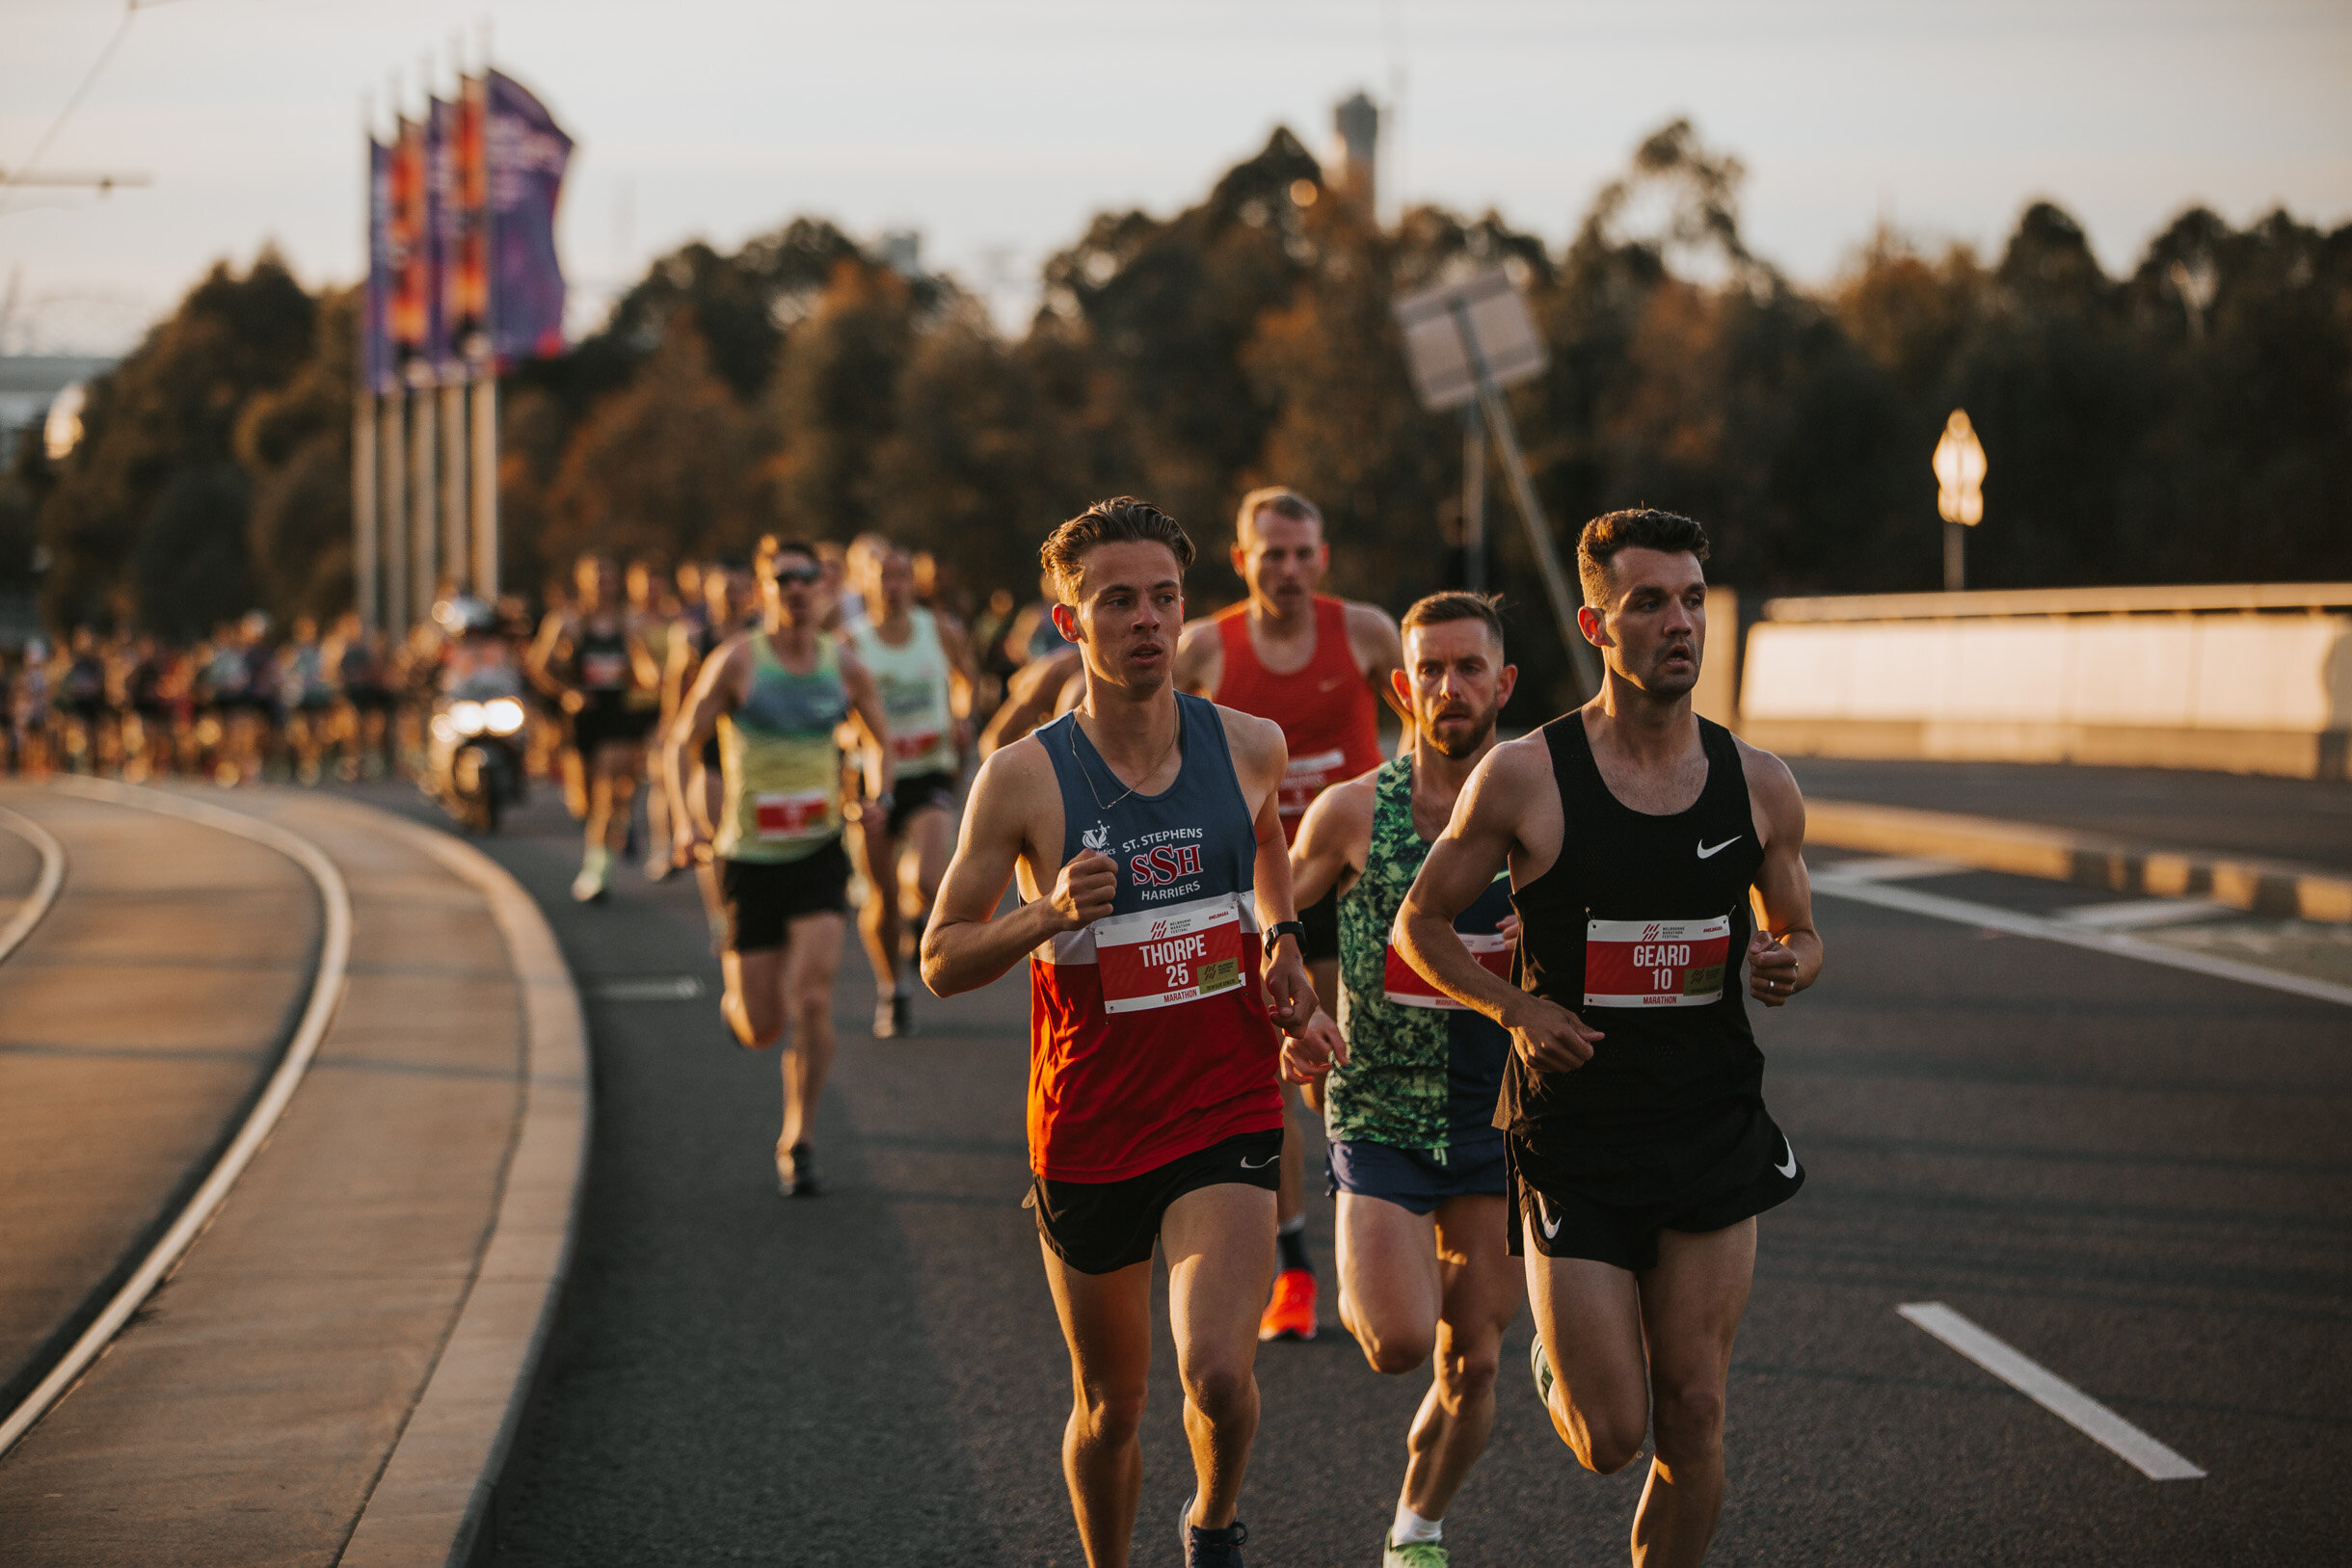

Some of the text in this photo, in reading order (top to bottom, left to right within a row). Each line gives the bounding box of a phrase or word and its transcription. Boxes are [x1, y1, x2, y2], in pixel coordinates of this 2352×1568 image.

[1122, 838, 1140, 853] ST.
[1140, 828, 1203, 845] STEPHENS
[1131, 843, 1203, 887] SSH
[1141, 881, 1201, 900] HARRIERS
[1139, 934, 1207, 968] THORPE
[1633, 944, 1691, 967] GEARD
[1165, 963, 1189, 988] 25
[1652, 969, 1672, 991] 10
[1163, 989, 1197, 1002] MARATHON
[1643, 996, 1677, 1004] MARATHON
